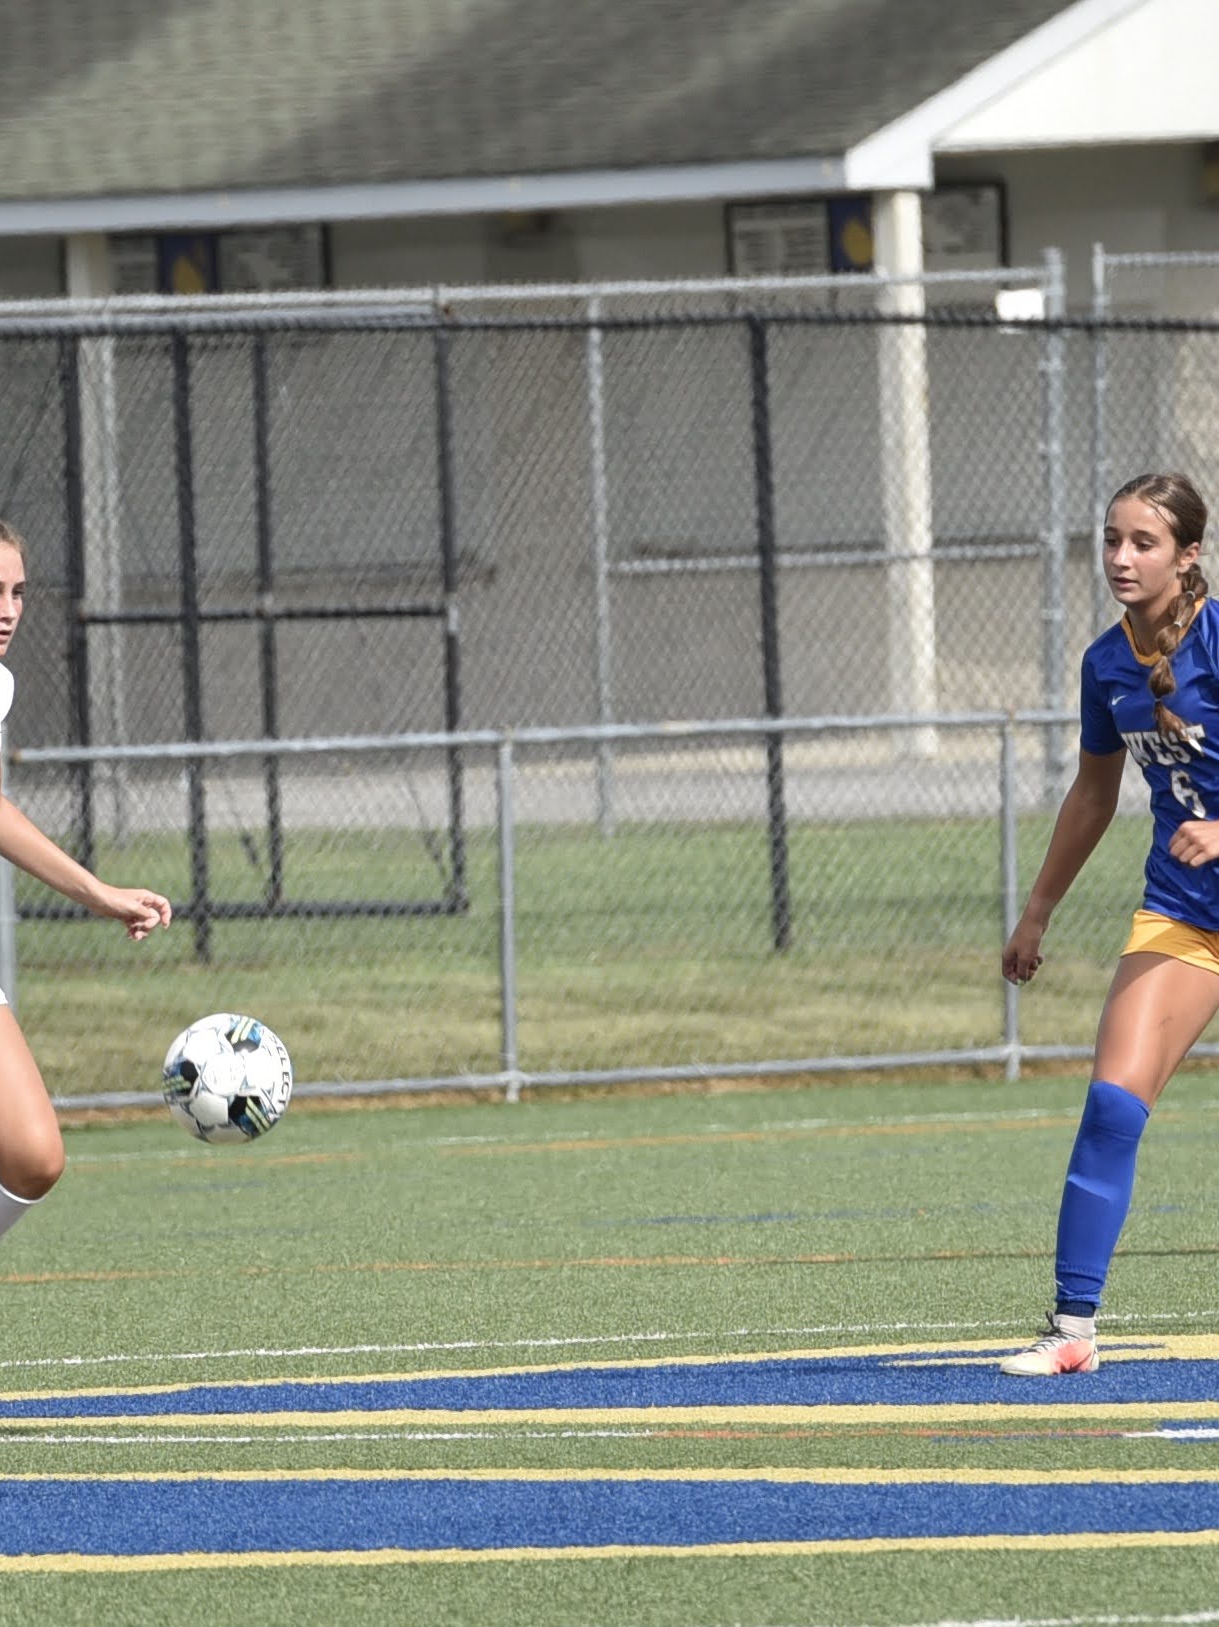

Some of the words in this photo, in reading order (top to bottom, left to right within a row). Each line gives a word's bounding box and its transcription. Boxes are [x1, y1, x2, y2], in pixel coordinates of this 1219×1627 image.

[1120, 723, 1206, 768] WEST
[1170, 769, 1207, 819] 6
[268, 1034, 291, 1107] SELECT
